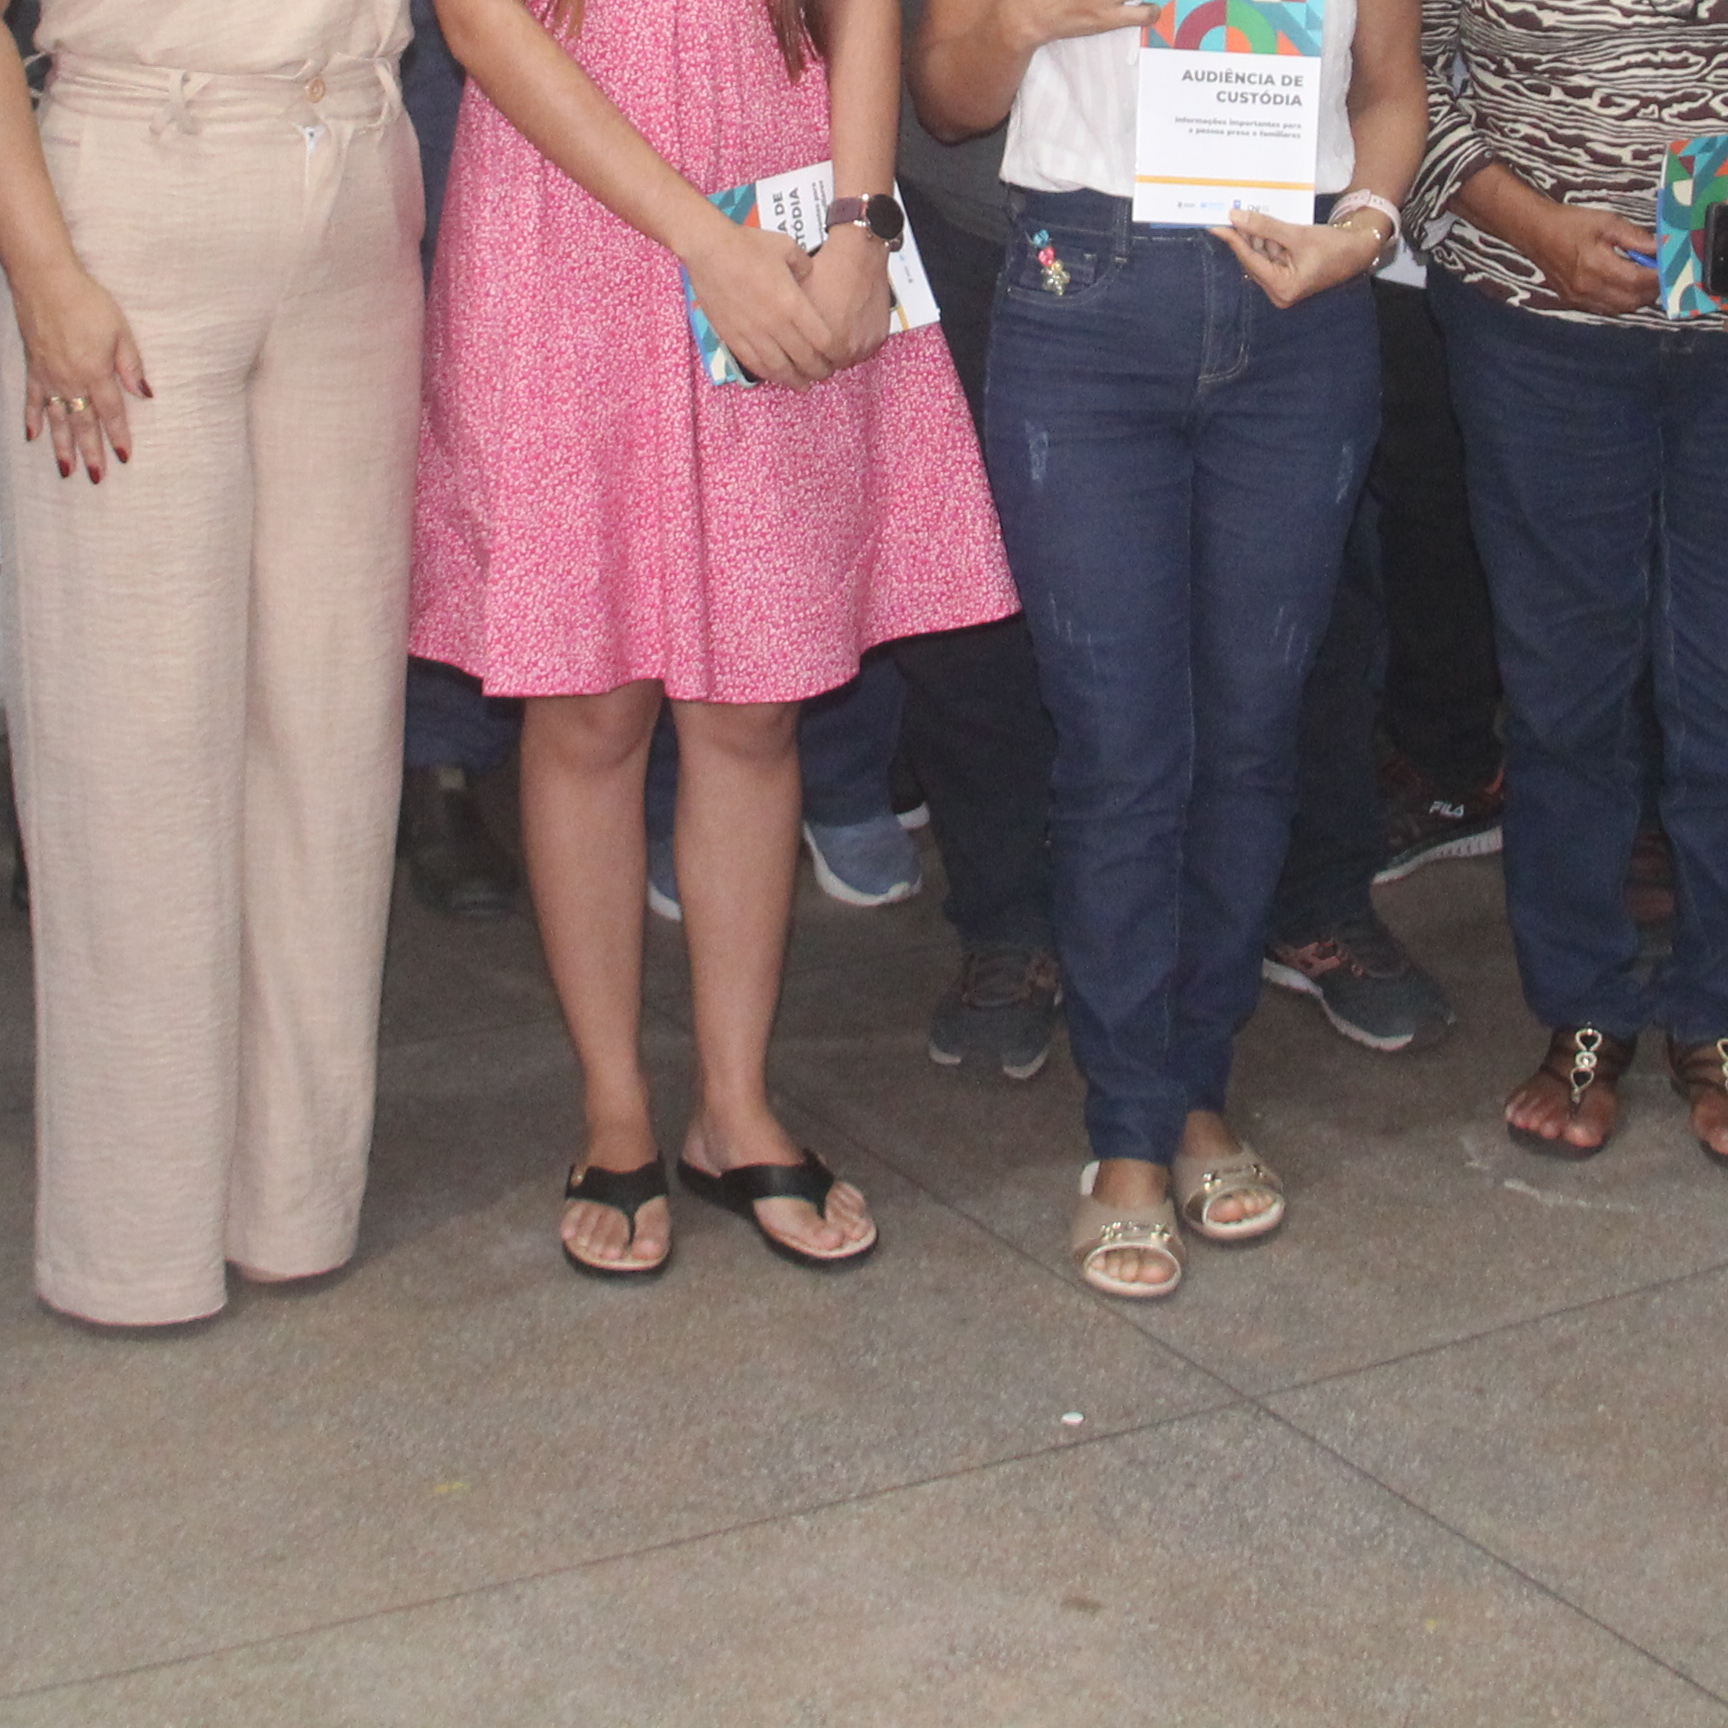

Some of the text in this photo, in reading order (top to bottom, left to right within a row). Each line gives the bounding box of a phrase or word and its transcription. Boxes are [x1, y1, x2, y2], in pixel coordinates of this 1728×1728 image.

[1181, 67, 1304, 87] AUDIÊNCIA DE
[1216, 88, 1303, 107] CUSTÓDIA
[772, 190, 785, 217] DE
[1429, 800, 1465, 819] FILA
